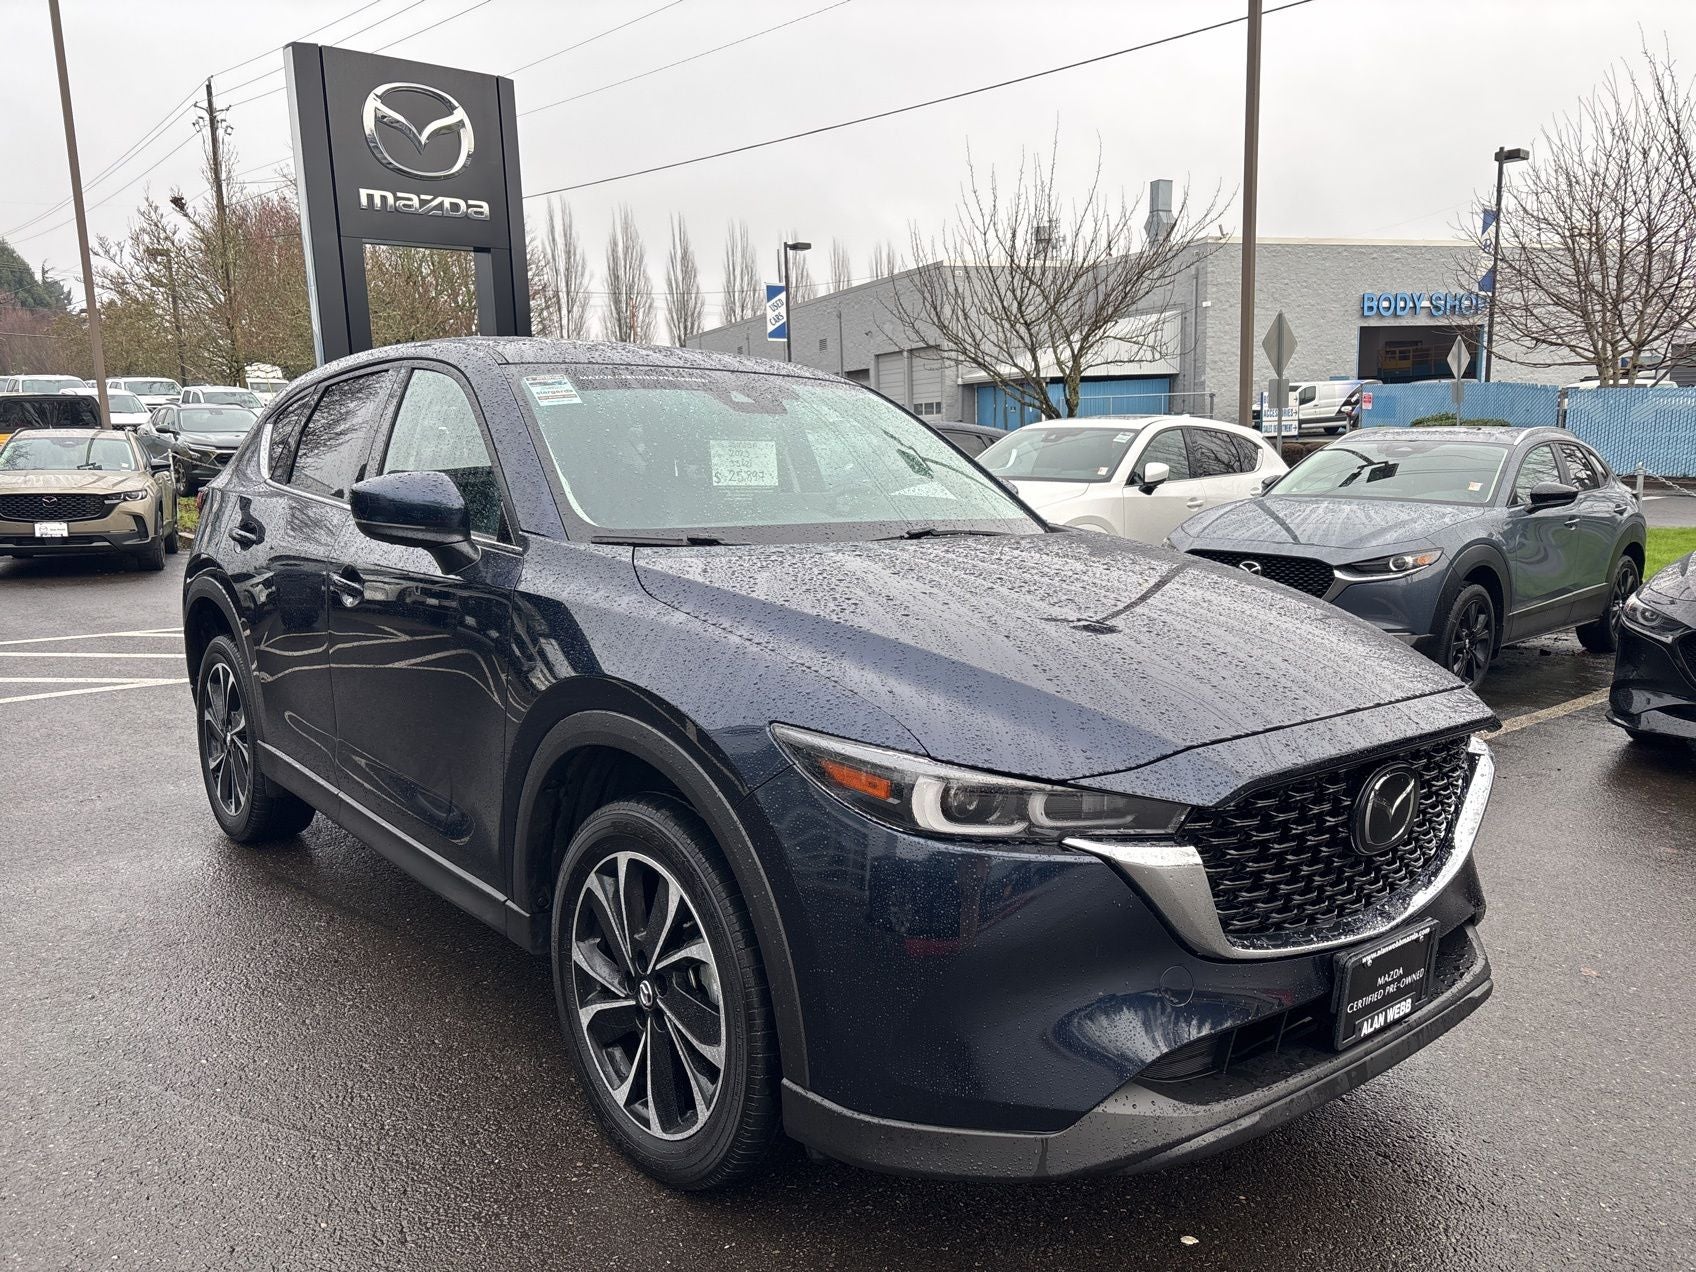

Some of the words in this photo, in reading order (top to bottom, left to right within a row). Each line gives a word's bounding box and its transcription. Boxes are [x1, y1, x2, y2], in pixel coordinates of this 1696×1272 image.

[768, 298, 785, 312] USED
[1361, 292, 1425, 317] BODY
[769, 312, 785, 326] CARS
[1263, 408, 1294, 418] ACCESRIES
[1376, 966, 1404, 987] MAZDA
[1347, 989, 1384, 1013] CERTIFIED
[1384, 968, 1425, 996] PRE-OWNED
[1361, 1011, 1385, 1037] ALAN
[1386, 998, 1412, 1023] WEBB
